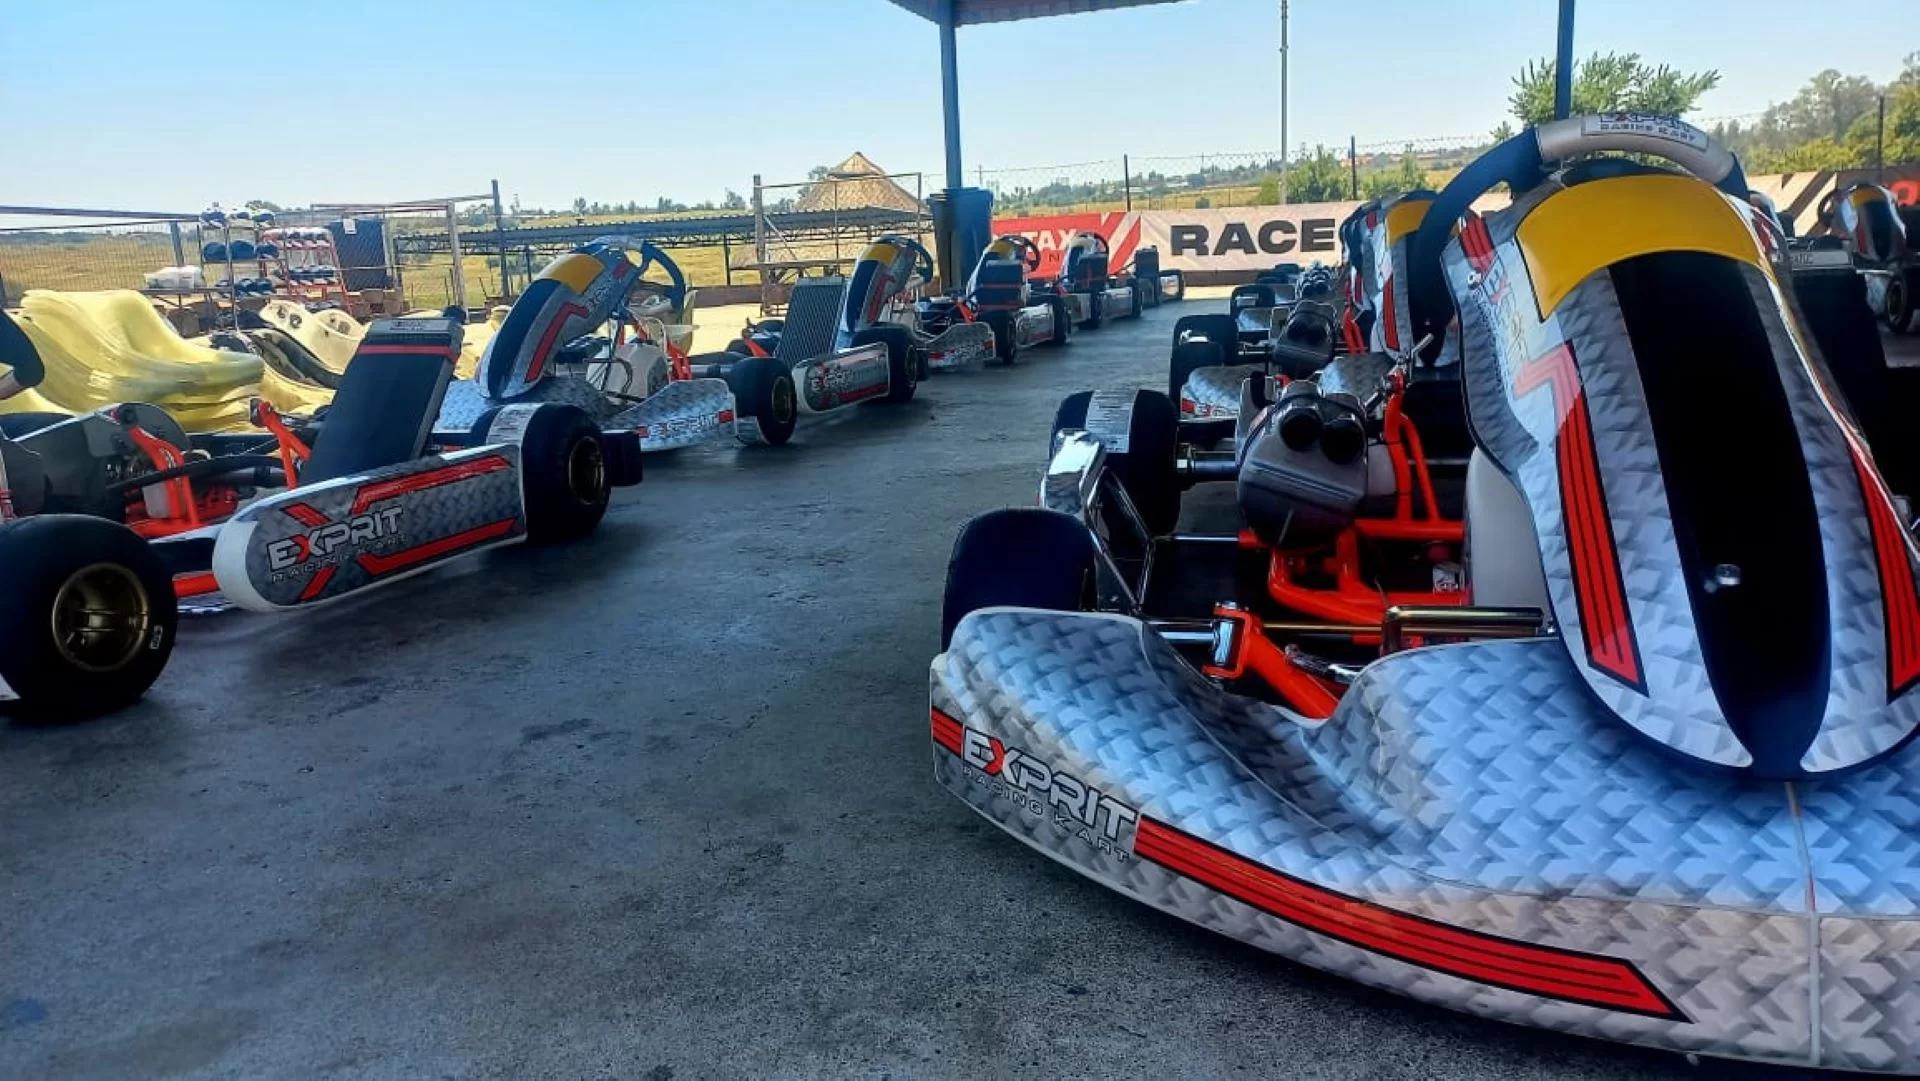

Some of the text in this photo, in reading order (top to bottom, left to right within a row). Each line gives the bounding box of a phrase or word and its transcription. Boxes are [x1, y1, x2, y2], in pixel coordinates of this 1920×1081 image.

[1021, 229, 1077, 251] TAX
[1170, 218, 1335, 256] RACE
[267, 504, 403, 571] EXPRIT
[962, 766, 1130, 862] RACING KART
[964, 726, 1139, 841] EXPRIT
